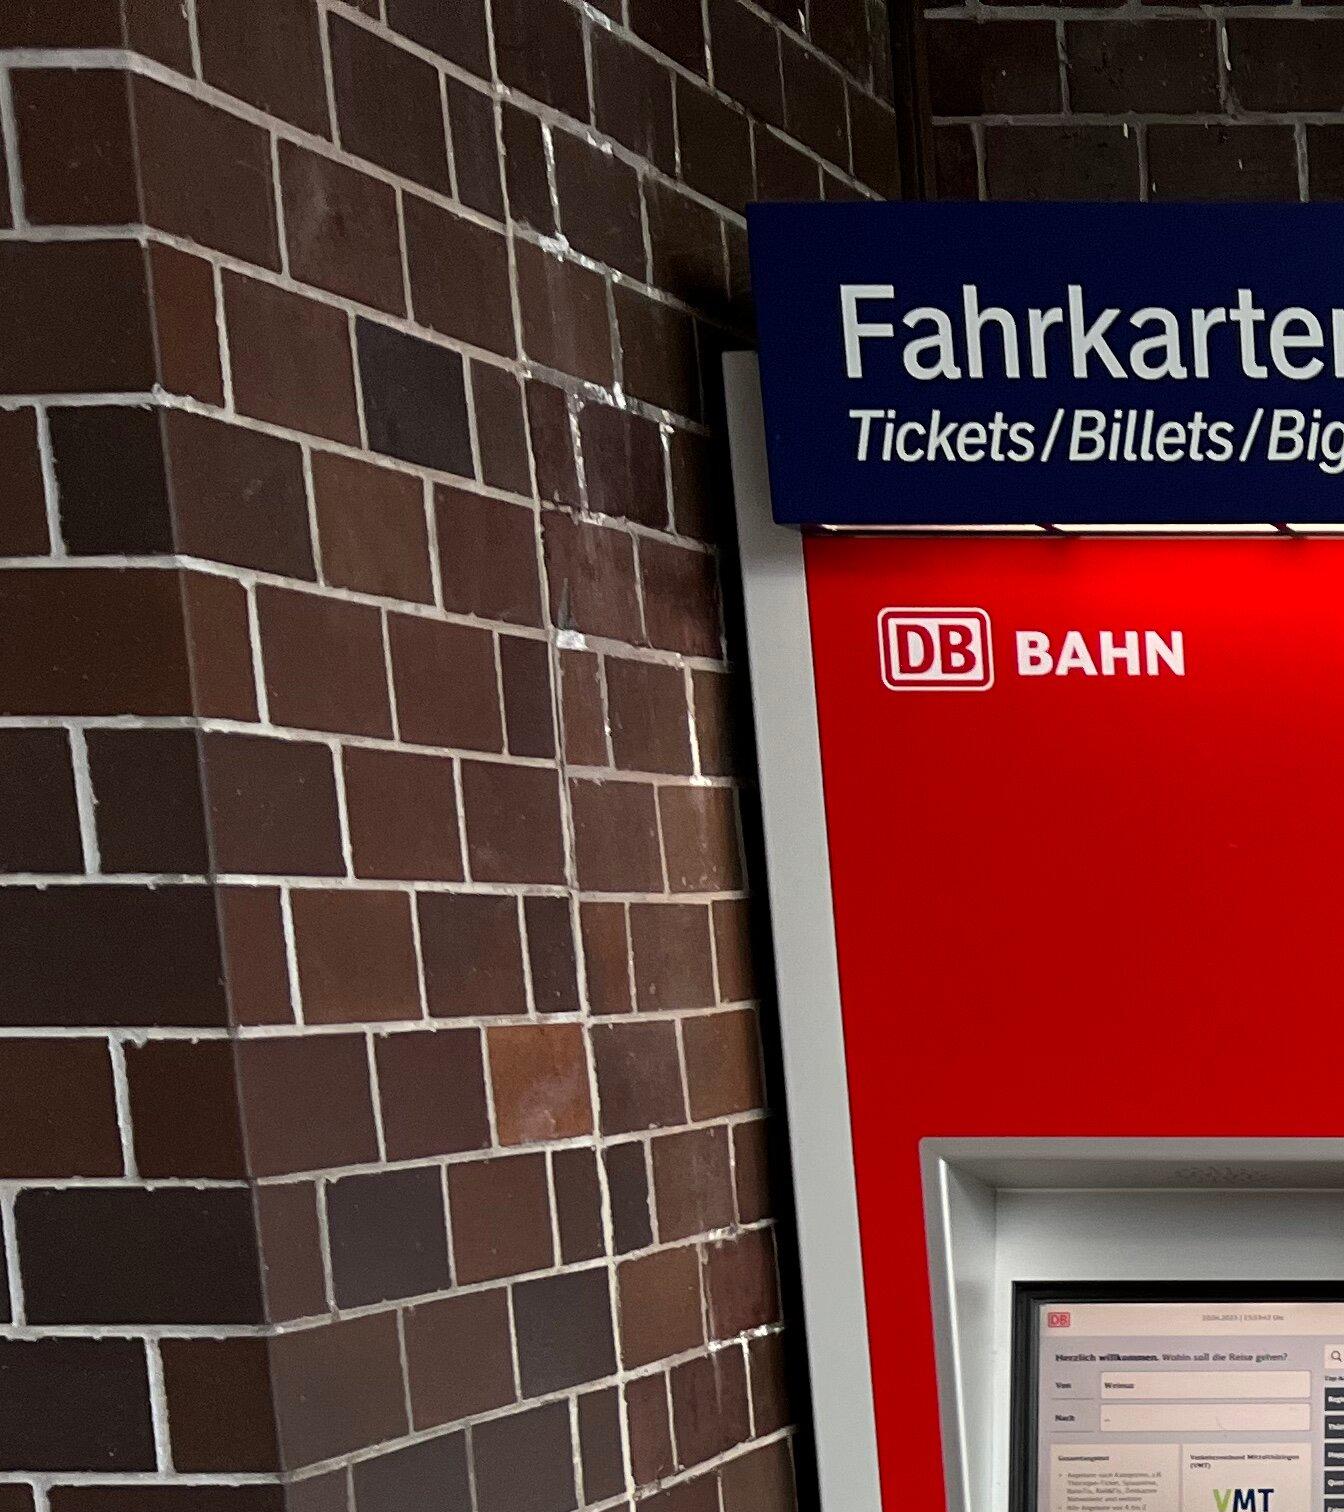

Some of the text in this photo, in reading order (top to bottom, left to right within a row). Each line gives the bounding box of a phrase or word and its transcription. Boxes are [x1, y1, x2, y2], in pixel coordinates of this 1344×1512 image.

[894, 622, 1186, 676] DB BAHN
[1213, 1488, 1274, 1512] VMT
